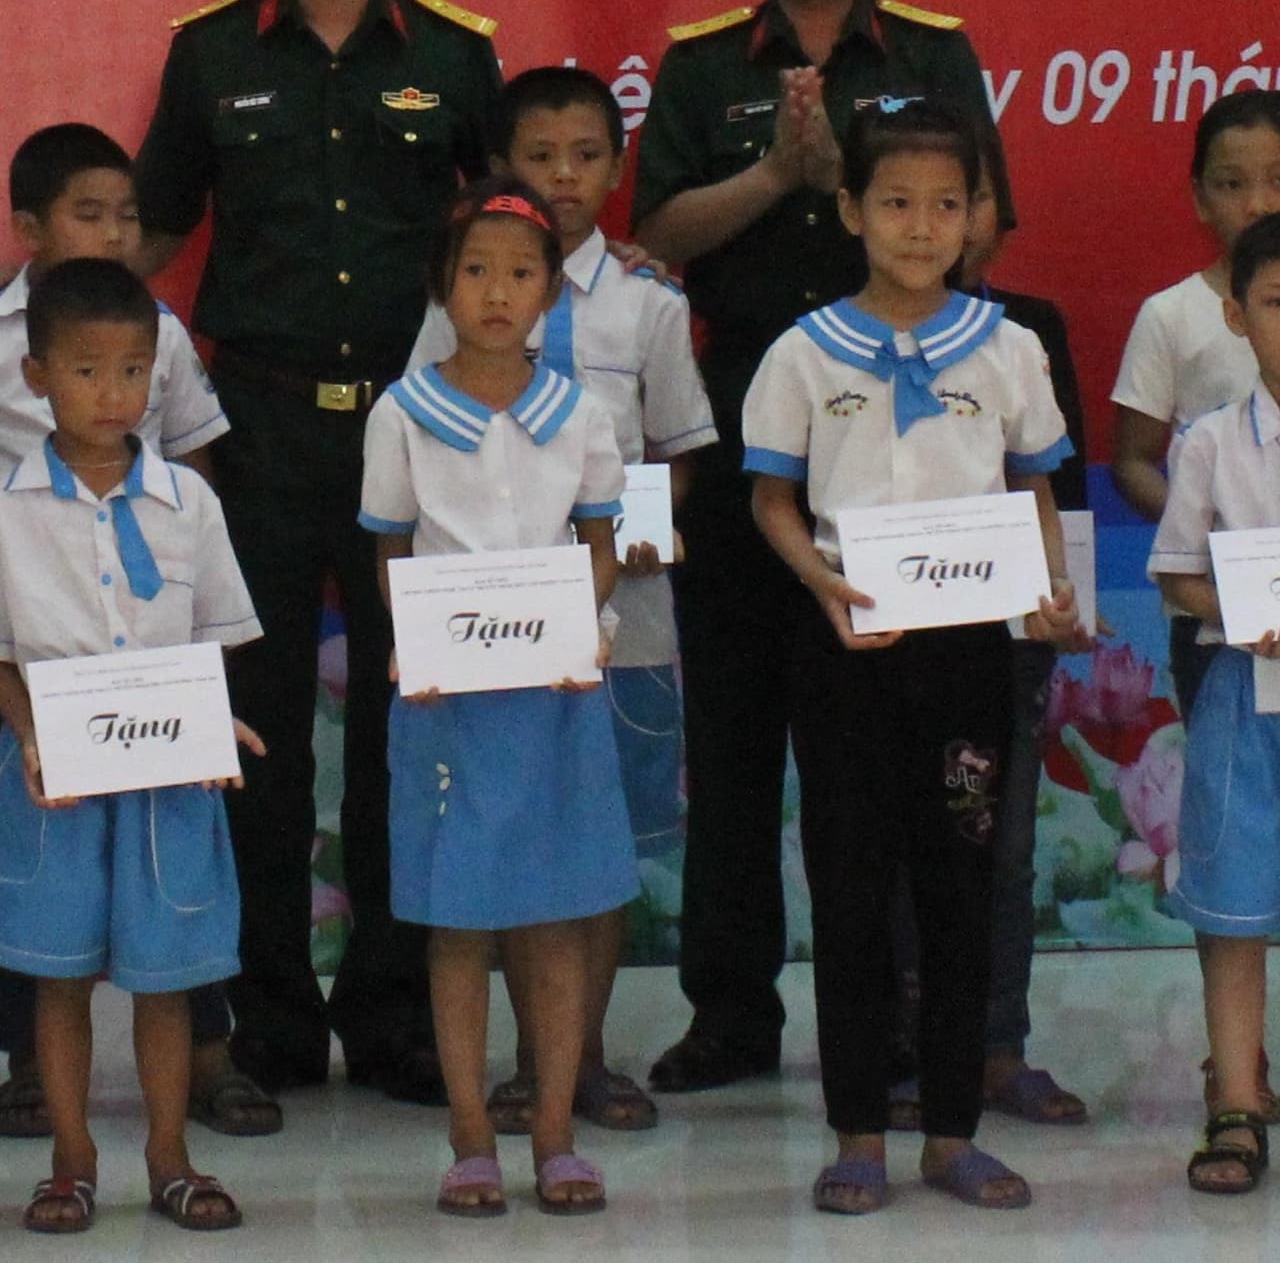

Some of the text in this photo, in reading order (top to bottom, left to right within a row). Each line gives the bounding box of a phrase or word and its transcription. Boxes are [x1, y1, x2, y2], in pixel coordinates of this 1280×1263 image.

[1043, 50, 1130, 124] 09
[897, 556, 995, 588] Tặng
[447, 612, 546, 648] Tặng
[87, 713, 182, 749] Tặng
